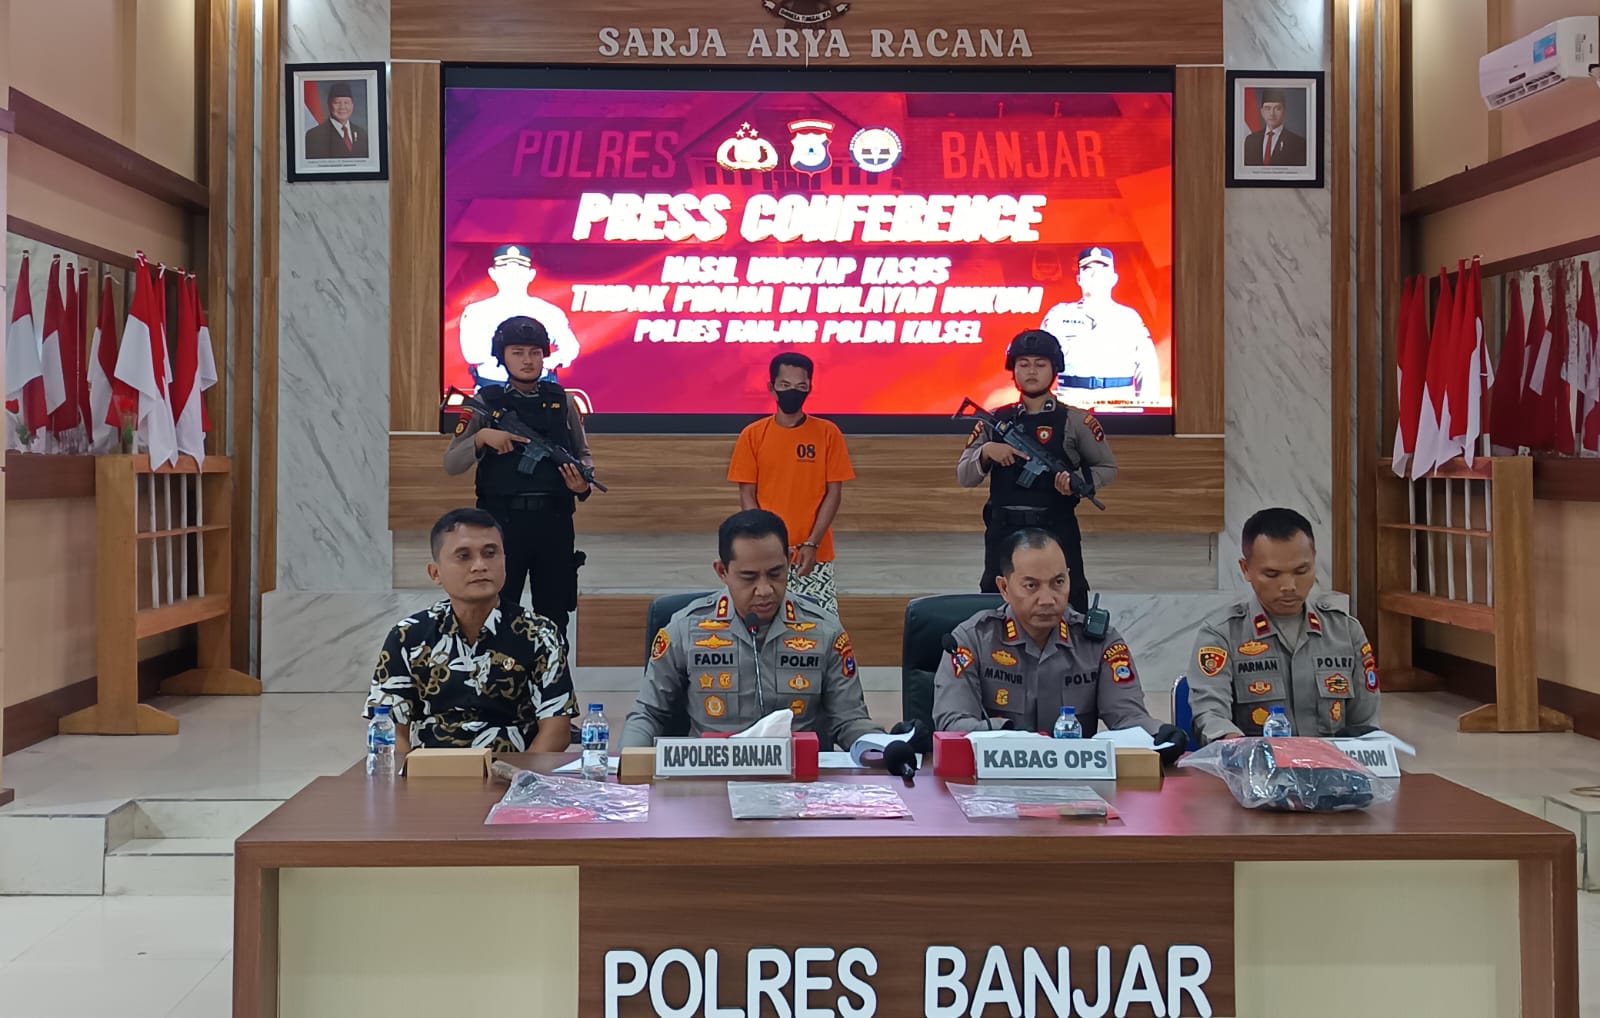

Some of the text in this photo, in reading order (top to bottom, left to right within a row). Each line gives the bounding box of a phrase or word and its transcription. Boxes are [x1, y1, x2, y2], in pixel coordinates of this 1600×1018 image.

[598, 27, 1033, 58] SARJA ARYA RACANA
[512, 130, 679, 178] POLRES
[941, 130, 1105, 179] BANJAR
[572, 192, 1047, 243] PRESS CONFERENCE
[661, 256, 739, 284] HASIL
[860, 257, 952, 285] KASUS
[571, 284, 670, 312] TINDAK
[672, 285, 774, 313] PIDANA
[779, 285, 811, 313] DI
[816, 286, 937, 314] WILAYAH
[633, 319, 982, 344] POLRES BANJAR POLDA KALSEL
[796, 444, 816, 459] 08
[694, 653, 734, 666] FADLI
[780, 655, 819, 667] POLRI
[1238, 660, 1278, 673] PARMAN
[1317, 657, 1352, 668] POLRI
[664, 745, 782, 767] KAPOLRES BANJAR
[983, 749, 1107, 769] KABAG OPS
[605, 945, 1212, 1018] POLRES BANJAR
